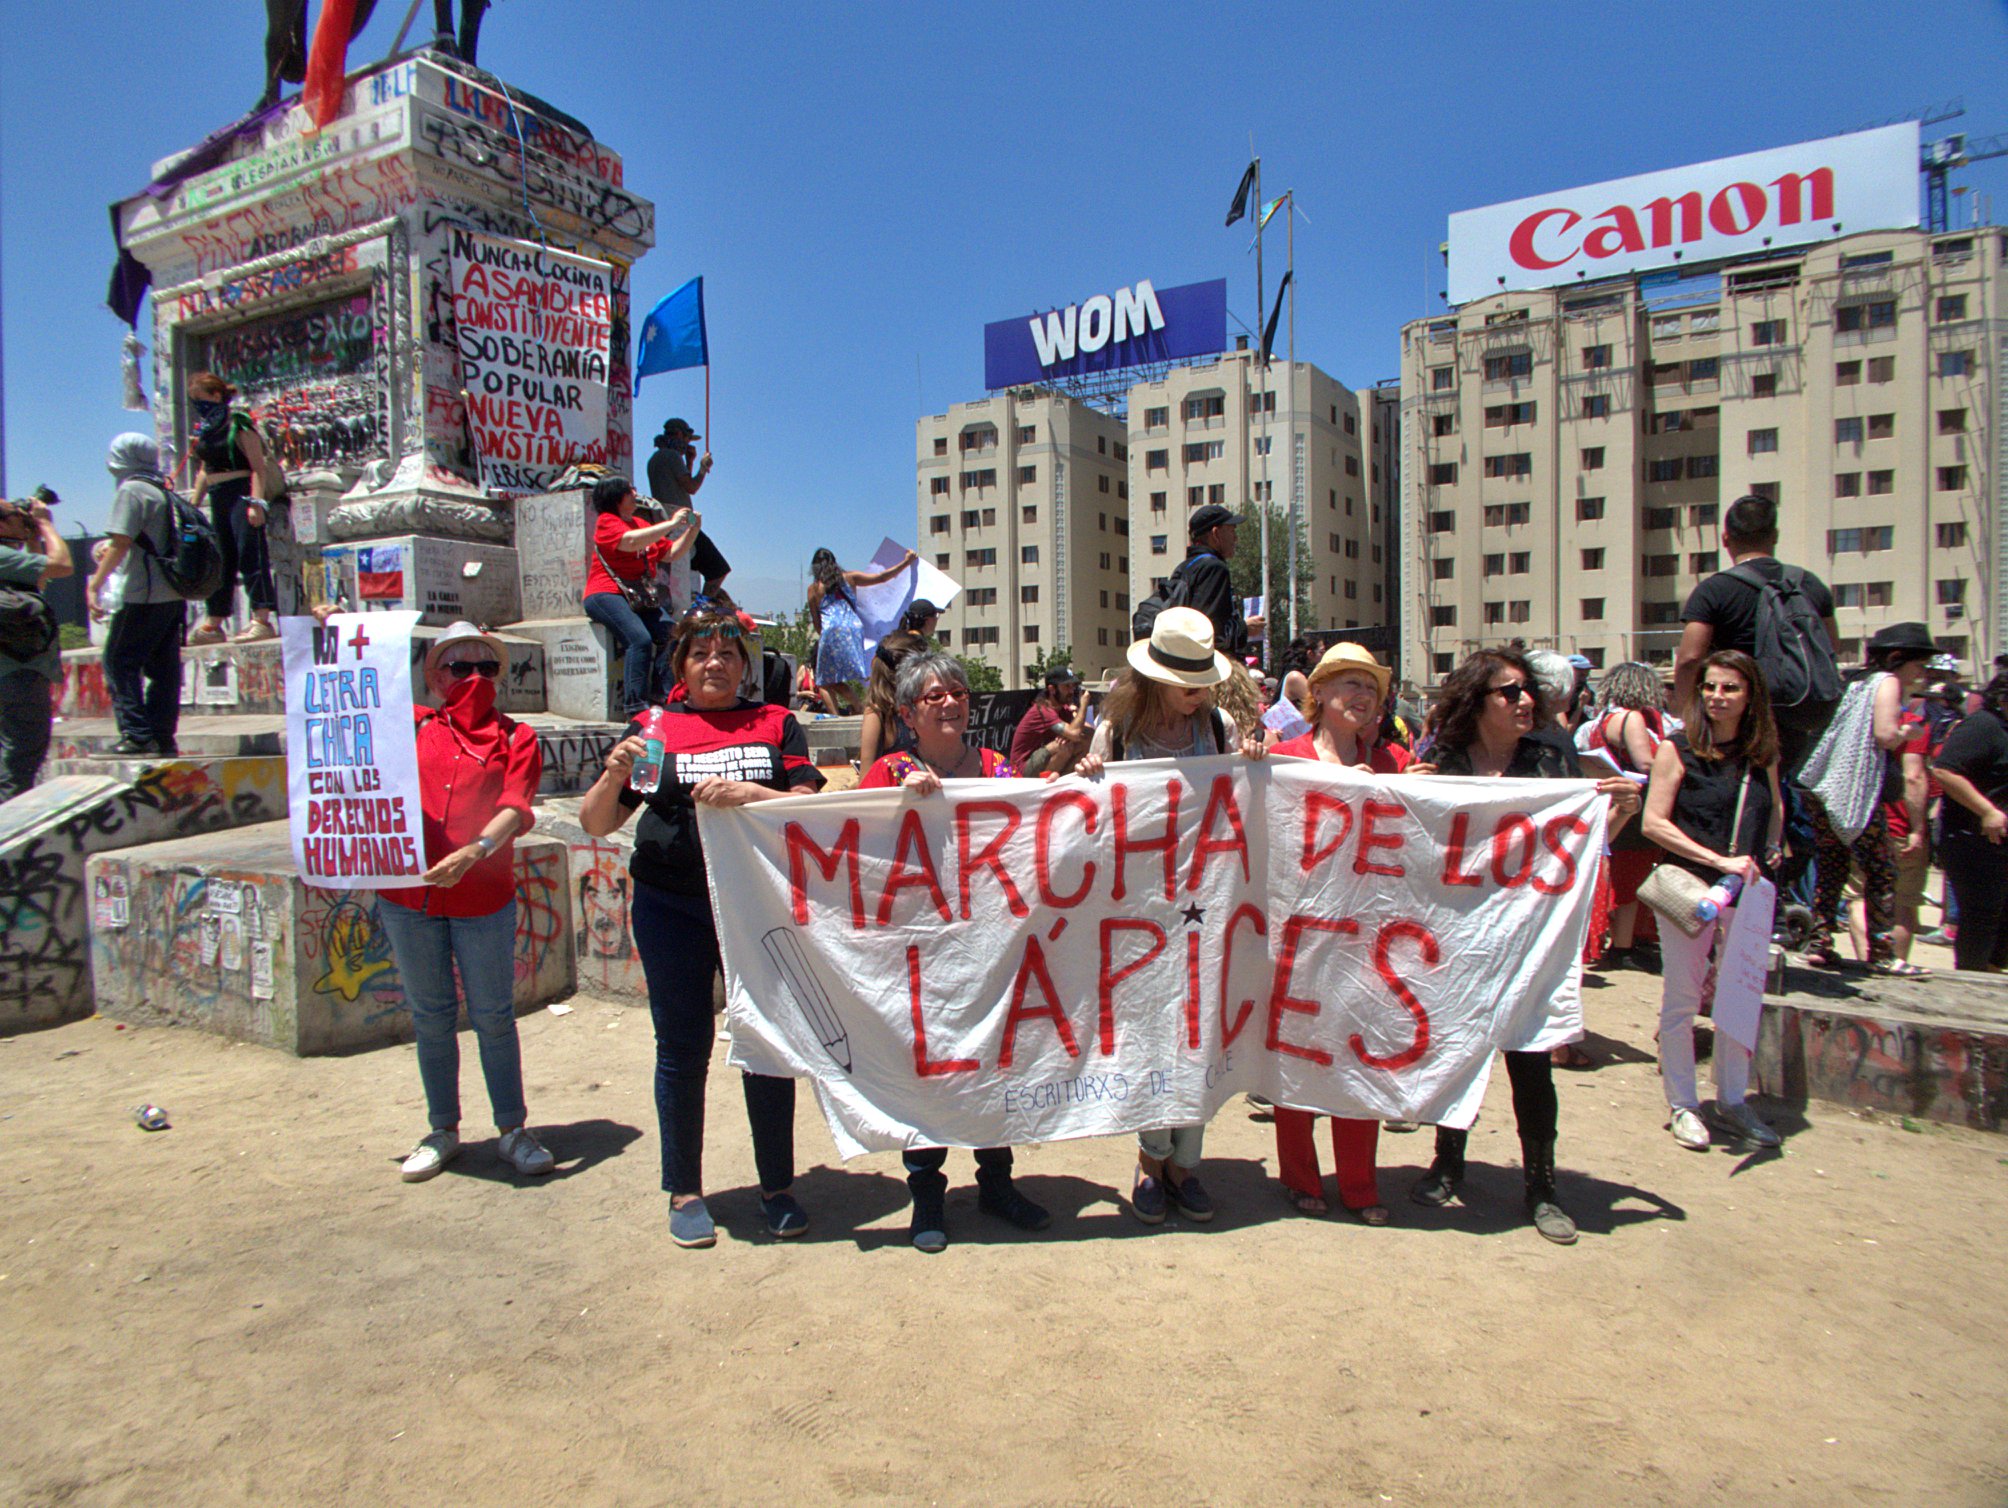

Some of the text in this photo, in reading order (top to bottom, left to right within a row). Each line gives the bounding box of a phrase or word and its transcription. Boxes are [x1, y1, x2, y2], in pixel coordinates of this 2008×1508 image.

[1508, 166, 1835, 271] Canon
[462, 262, 610, 321] ASAMBLEA
[452, 293, 611, 352] CONSTITUYENTE
[1029, 278, 1166, 367] WOM
[459, 326, 606, 384] SOBERANÍA
[461, 360, 583, 412] POPULAR
[468, 392, 563, 438] NUEVA
[305, 667, 381, 714] LETRA
[305, 713, 374, 768] CHICA
[308, 770, 345, 794] CON
[352, 768, 381, 792] LOS
[745, 769, 773, 781] DIAS
[308, 796, 407, 835] DERECHOS
[302, 836, 420, 877] HUMANOS
[783, 773, 1590, 930] MARCHA DE LOS
[906, 901, 1440, 1077] LÁPICES
[1005, 1072, 1129, 1114] ESCRITORXS
[1150, 1069, 1175, 1096] DE
